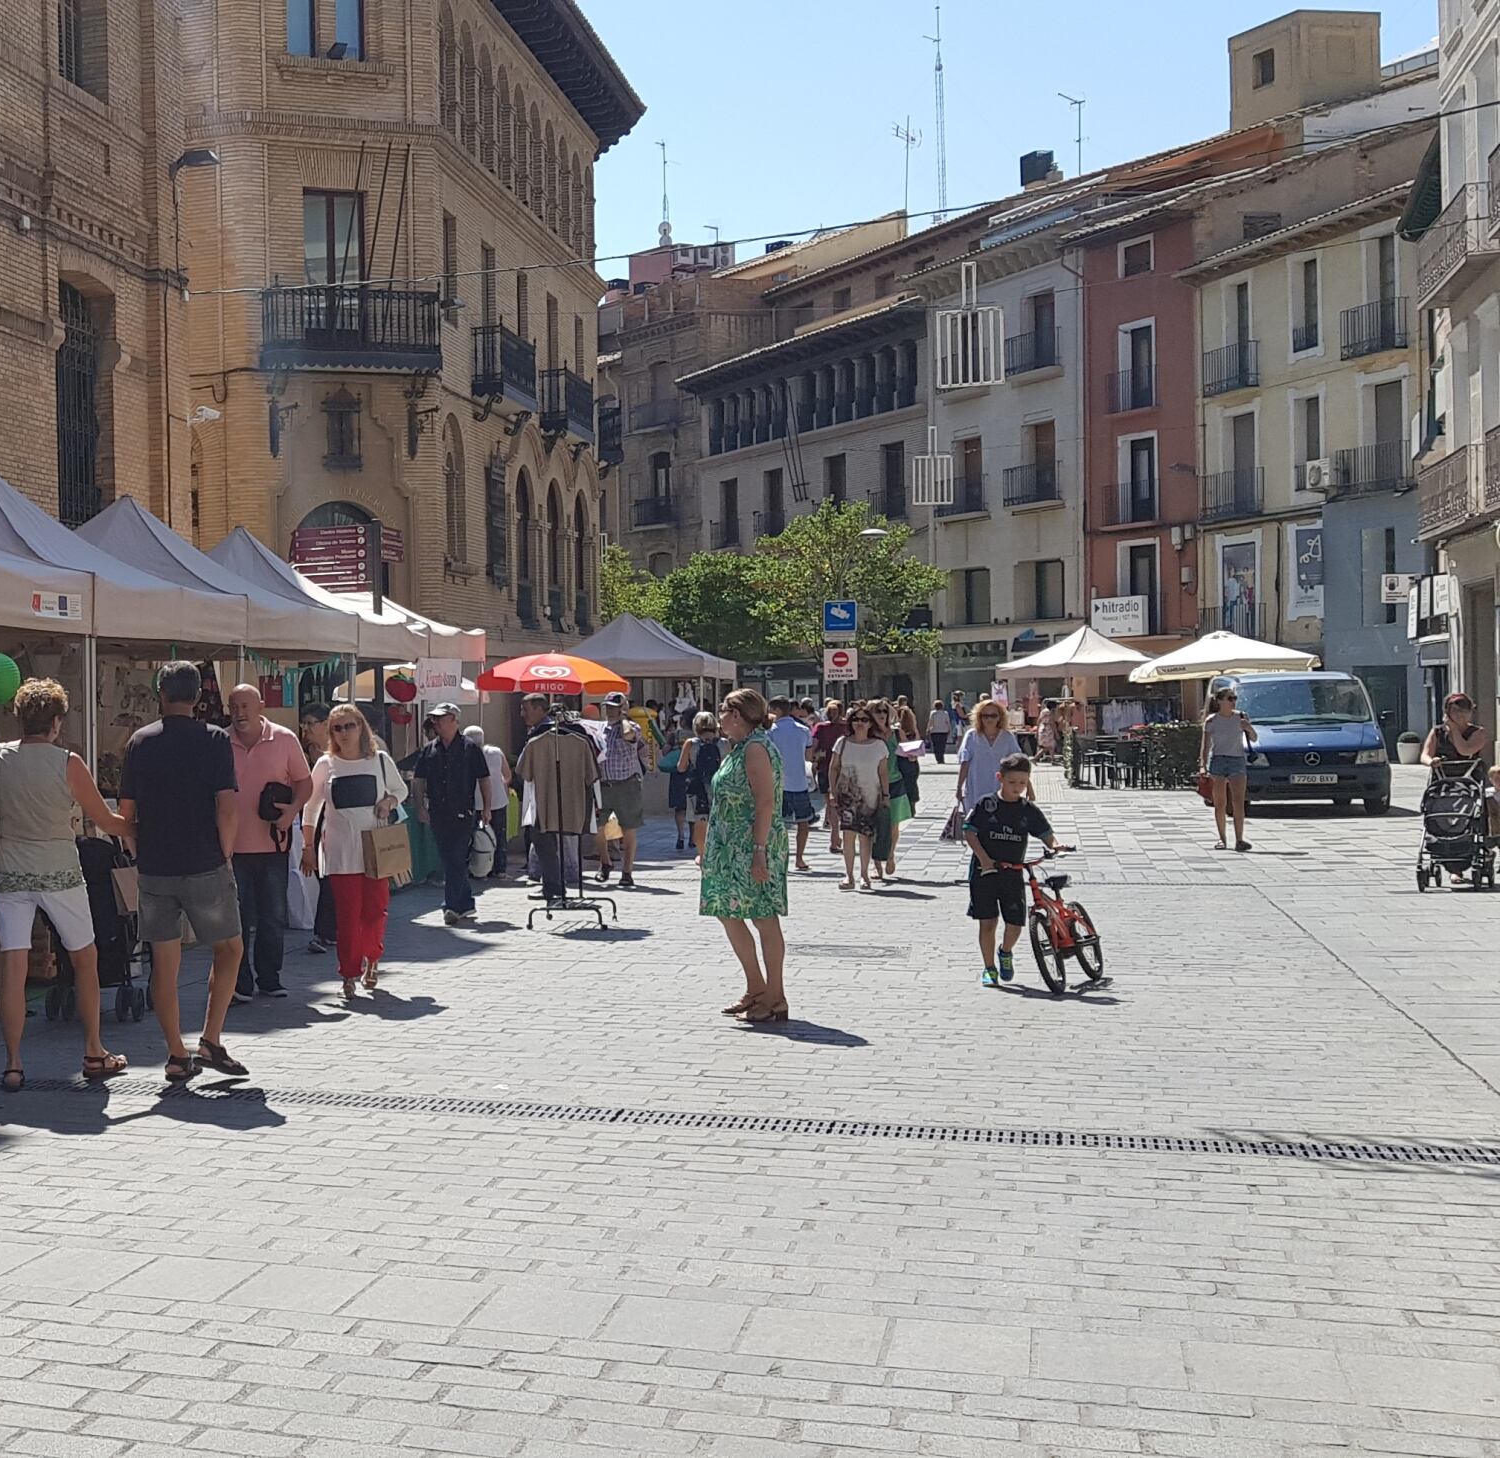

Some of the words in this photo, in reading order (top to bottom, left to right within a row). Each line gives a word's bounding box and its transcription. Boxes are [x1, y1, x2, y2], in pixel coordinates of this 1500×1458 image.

[1102, 600, 1139, 613] hitradio
[534, 682, 564, 691] FRIGO
[989, 830, 1022, 842] Emirates
